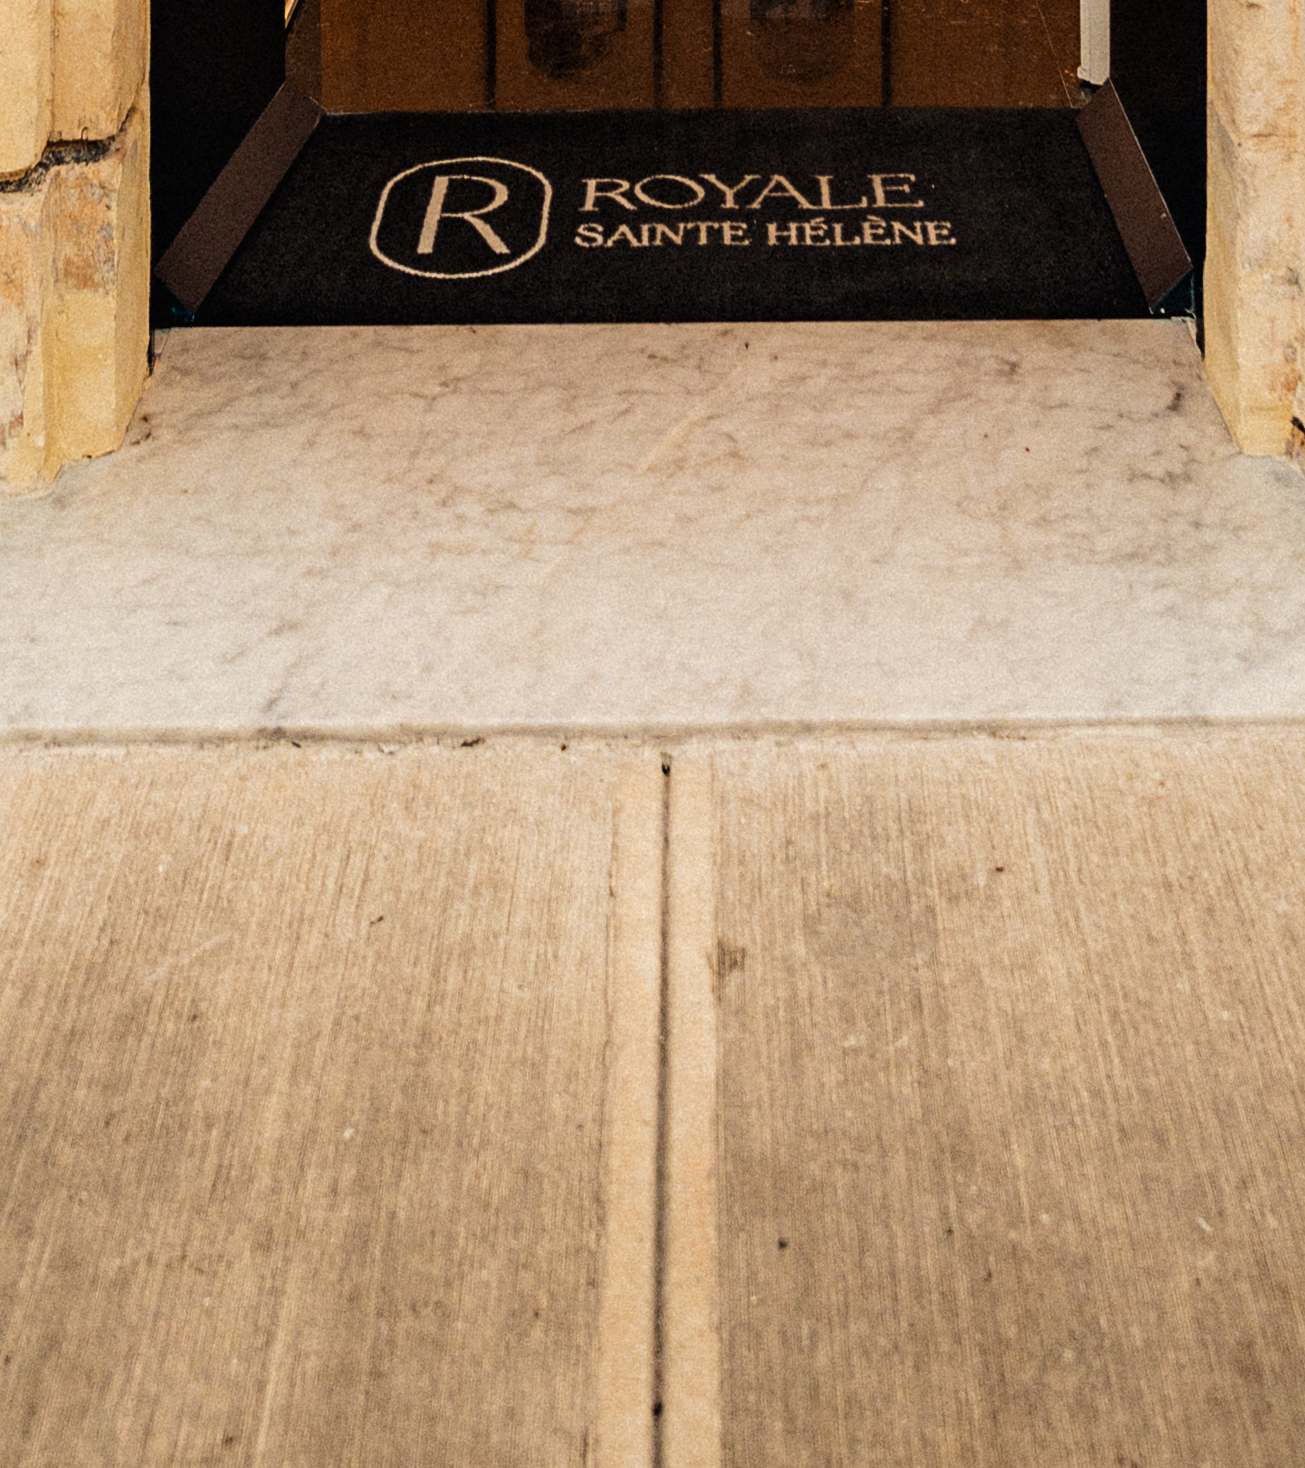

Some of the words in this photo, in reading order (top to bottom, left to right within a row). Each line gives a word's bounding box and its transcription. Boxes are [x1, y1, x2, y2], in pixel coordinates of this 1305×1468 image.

[580, 172, 925, 212] ROYALE
[416, 175, 511, 255] R
[574, 221, 750, 248] SAINTE
[766, 215, 958, 247] HÉLÈNE
